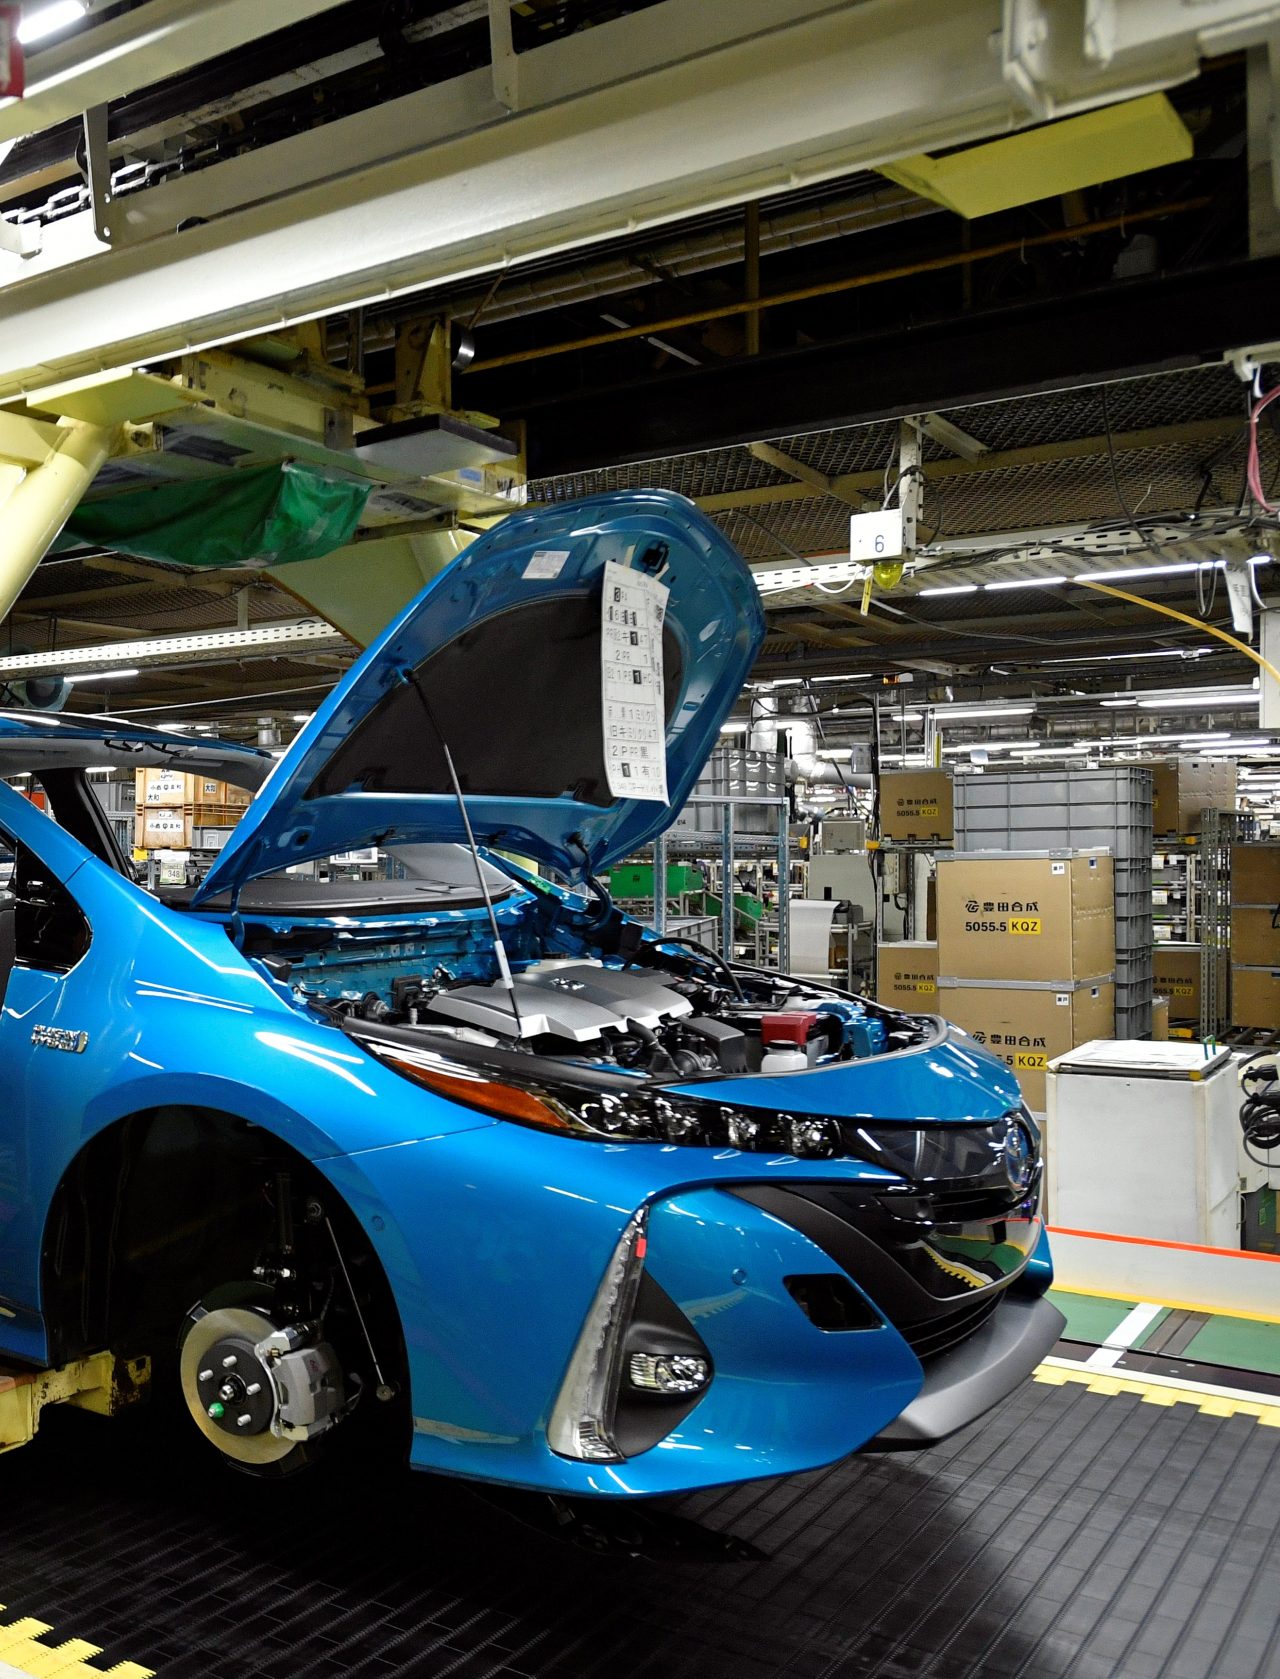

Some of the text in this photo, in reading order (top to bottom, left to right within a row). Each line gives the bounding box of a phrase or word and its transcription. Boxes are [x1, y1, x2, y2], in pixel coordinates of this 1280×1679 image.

[875, 535, 884, 553] 6
[168, 869, 180, 879] 348
[983, 901, 1039, 912] 豊田合成
[965, 921, 1038, 932] 5055.5 KQZ
[1153, 987, 1174, 995] 055.5
[1018, 1056, 1044, 1067] KQZ
